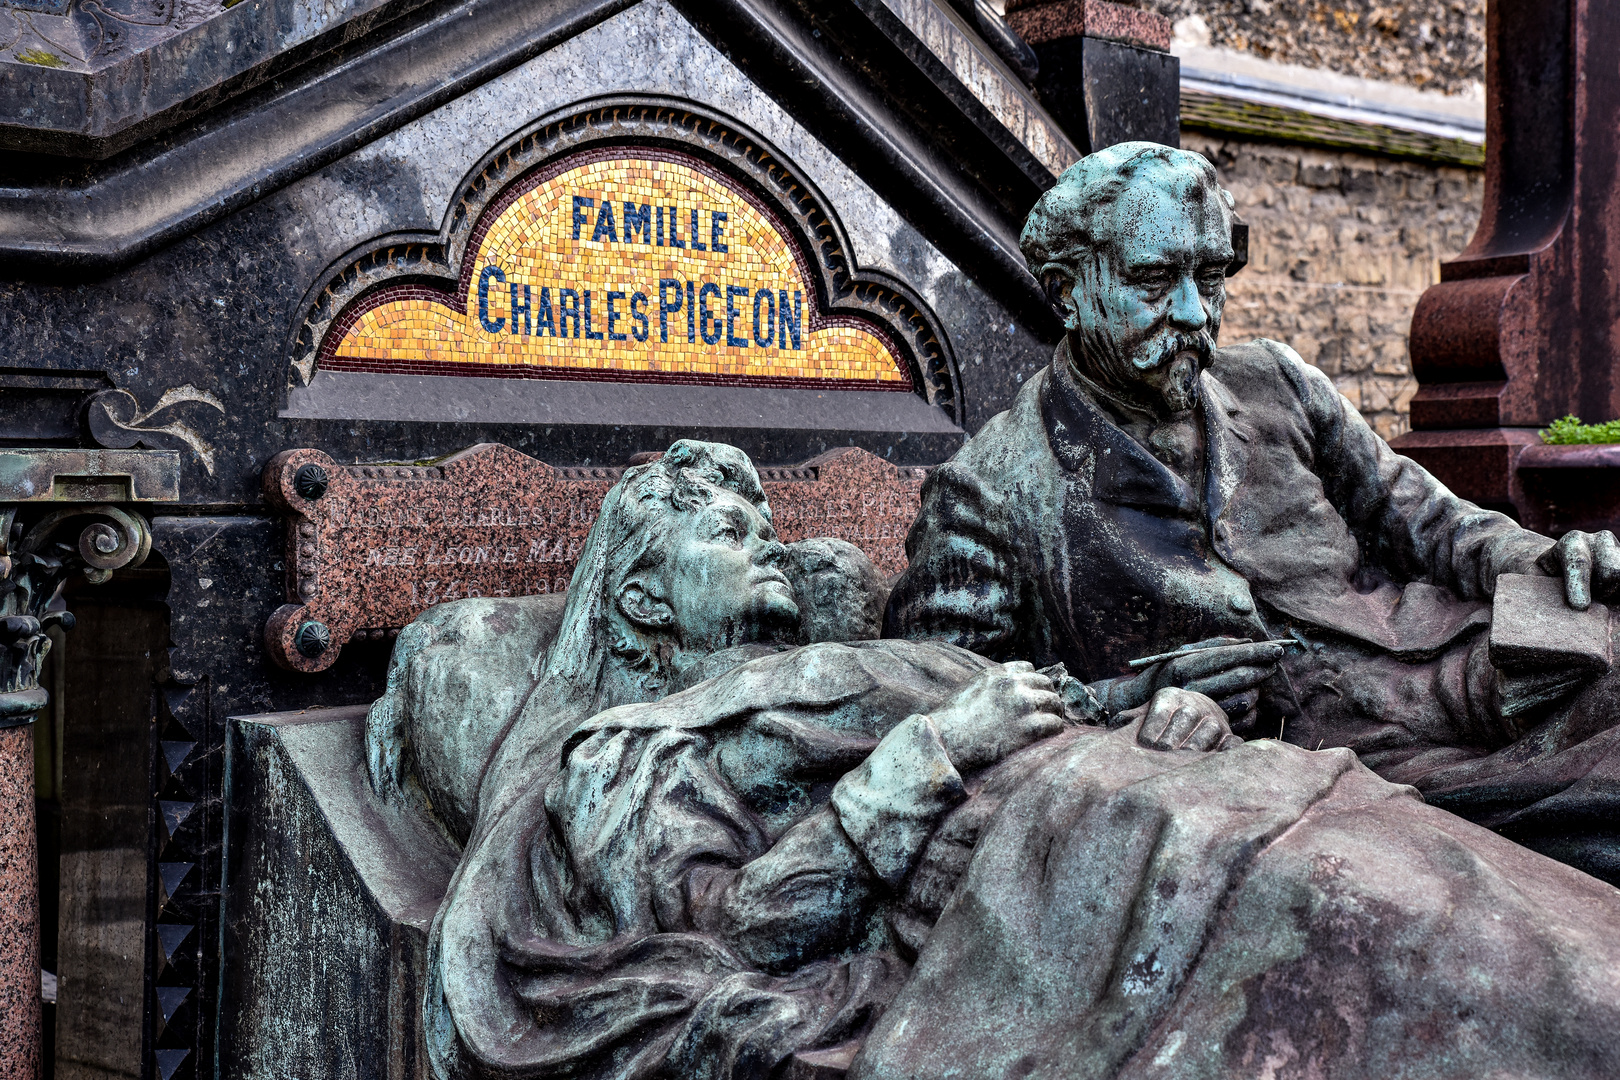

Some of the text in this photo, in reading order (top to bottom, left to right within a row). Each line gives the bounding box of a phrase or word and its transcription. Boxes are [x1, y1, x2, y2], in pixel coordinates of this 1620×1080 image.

[572, 195, 728, 253] FAMILLE
[478, 265, 801, 350] CHARLES PIGEON
[440, 499, 545, 527] CHARLES
